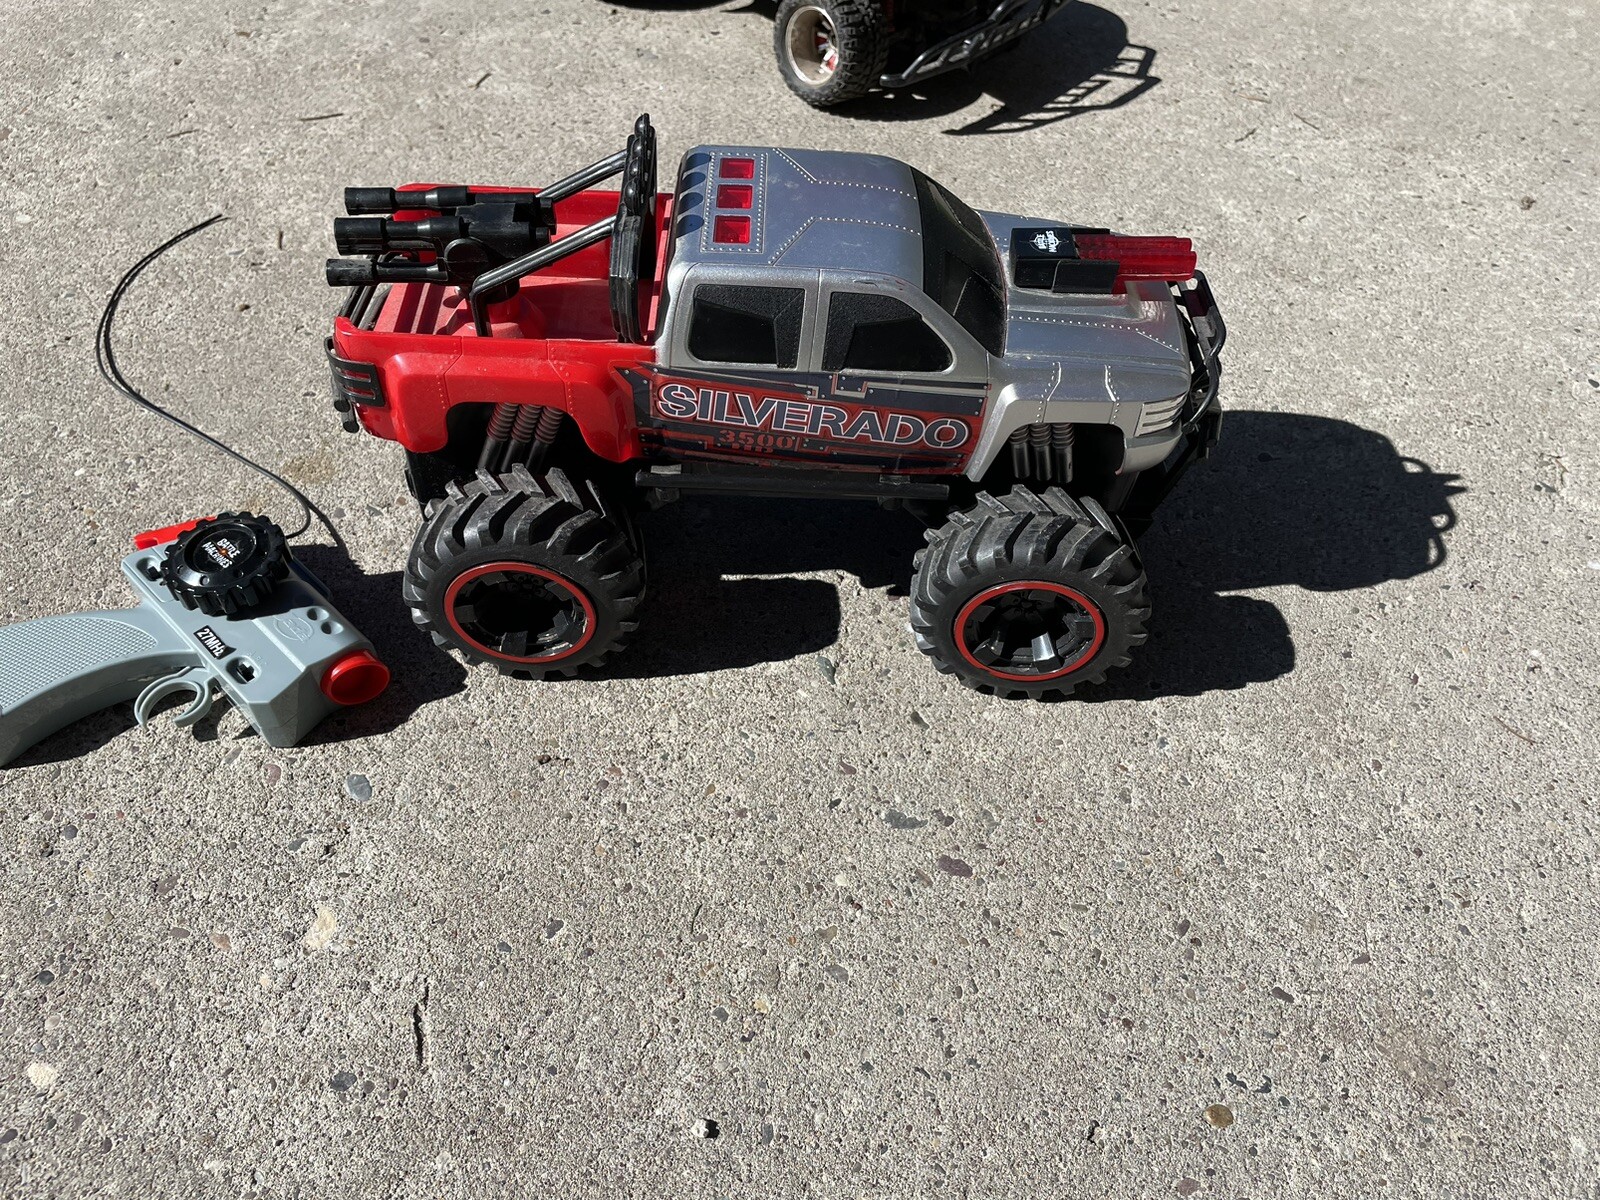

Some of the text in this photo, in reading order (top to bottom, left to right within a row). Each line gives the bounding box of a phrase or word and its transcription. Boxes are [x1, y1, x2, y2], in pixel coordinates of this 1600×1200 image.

[658, 384, 969, 448] SILVERADO
[719, 429, 793, 449] 3500
[202, 542, 232, 568] MACHINES
[217, 538, 240, 558] BATTLE
[197, 628, 225, 657] 27MHz
